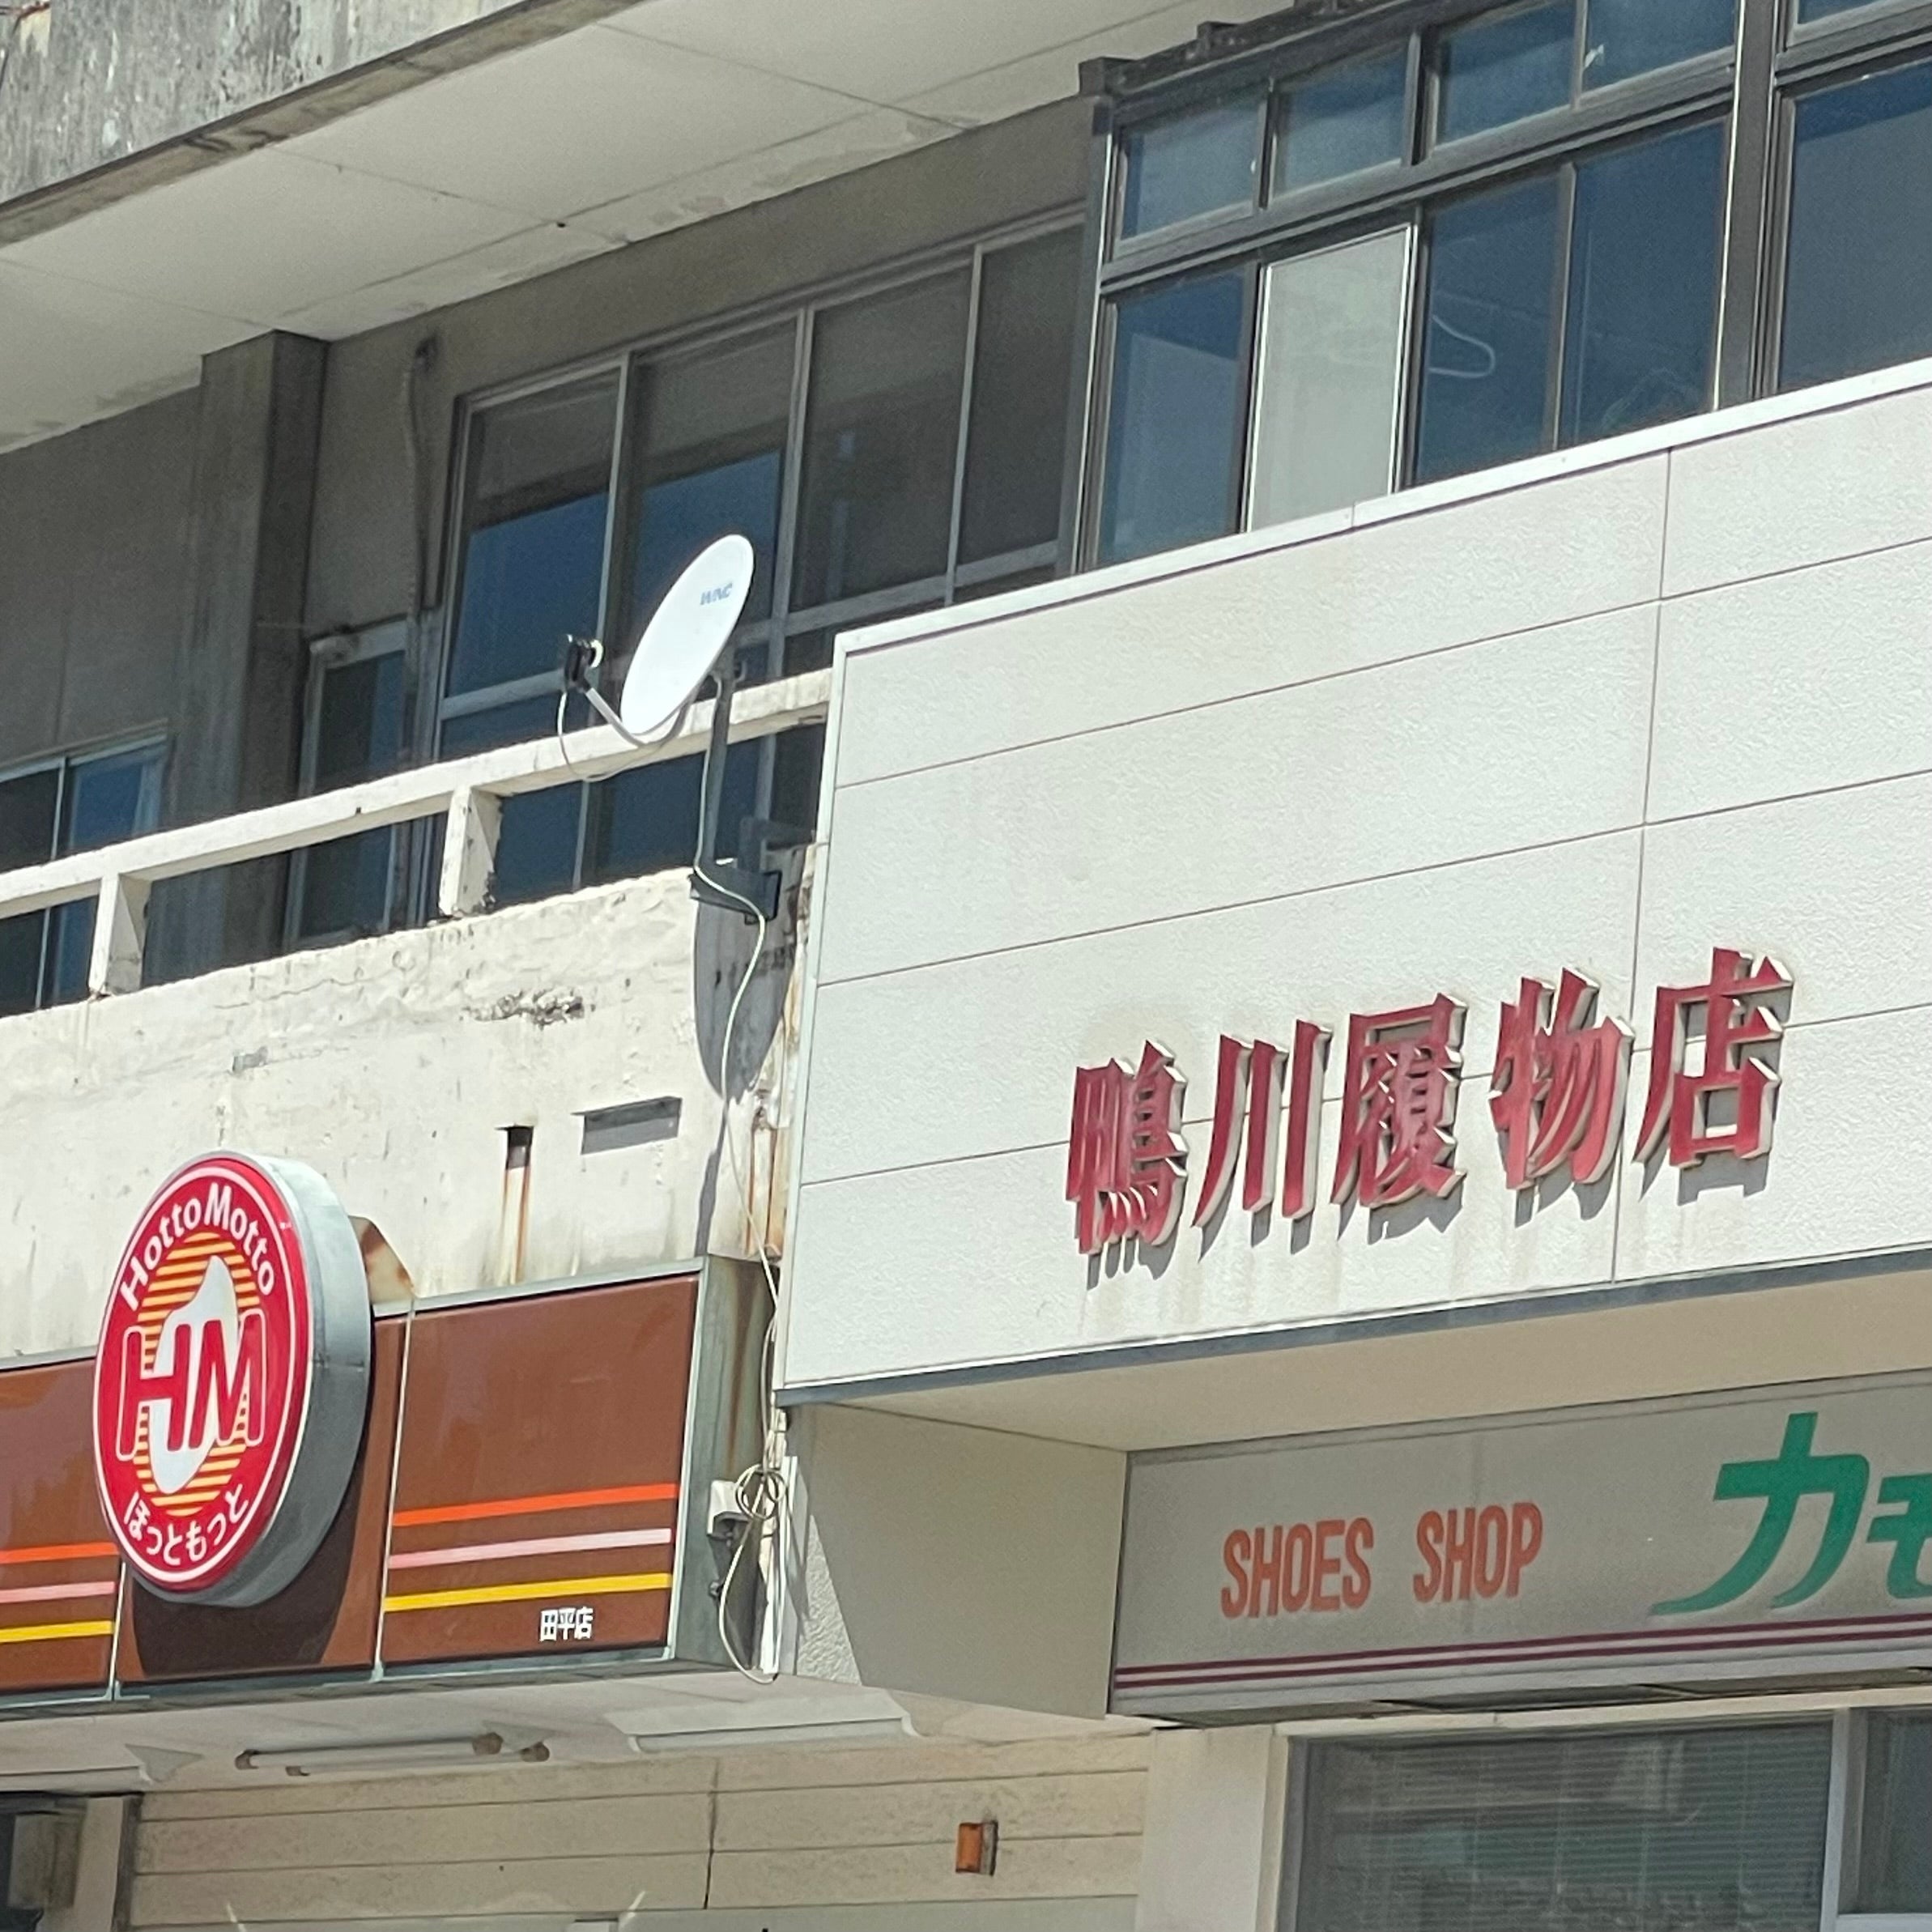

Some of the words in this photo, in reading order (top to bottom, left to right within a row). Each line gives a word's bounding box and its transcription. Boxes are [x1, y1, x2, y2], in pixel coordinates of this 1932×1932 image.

[1066, 947, 1794, 1254] 鴨川履物店
[123, 1483, 249, 1567] ほっともっと
[1220, 1517, 1375, 1619] SHOES
[1412, 1501, 1543, 1603] SHOP
[539, 1606, 594, 1642] 田平店
